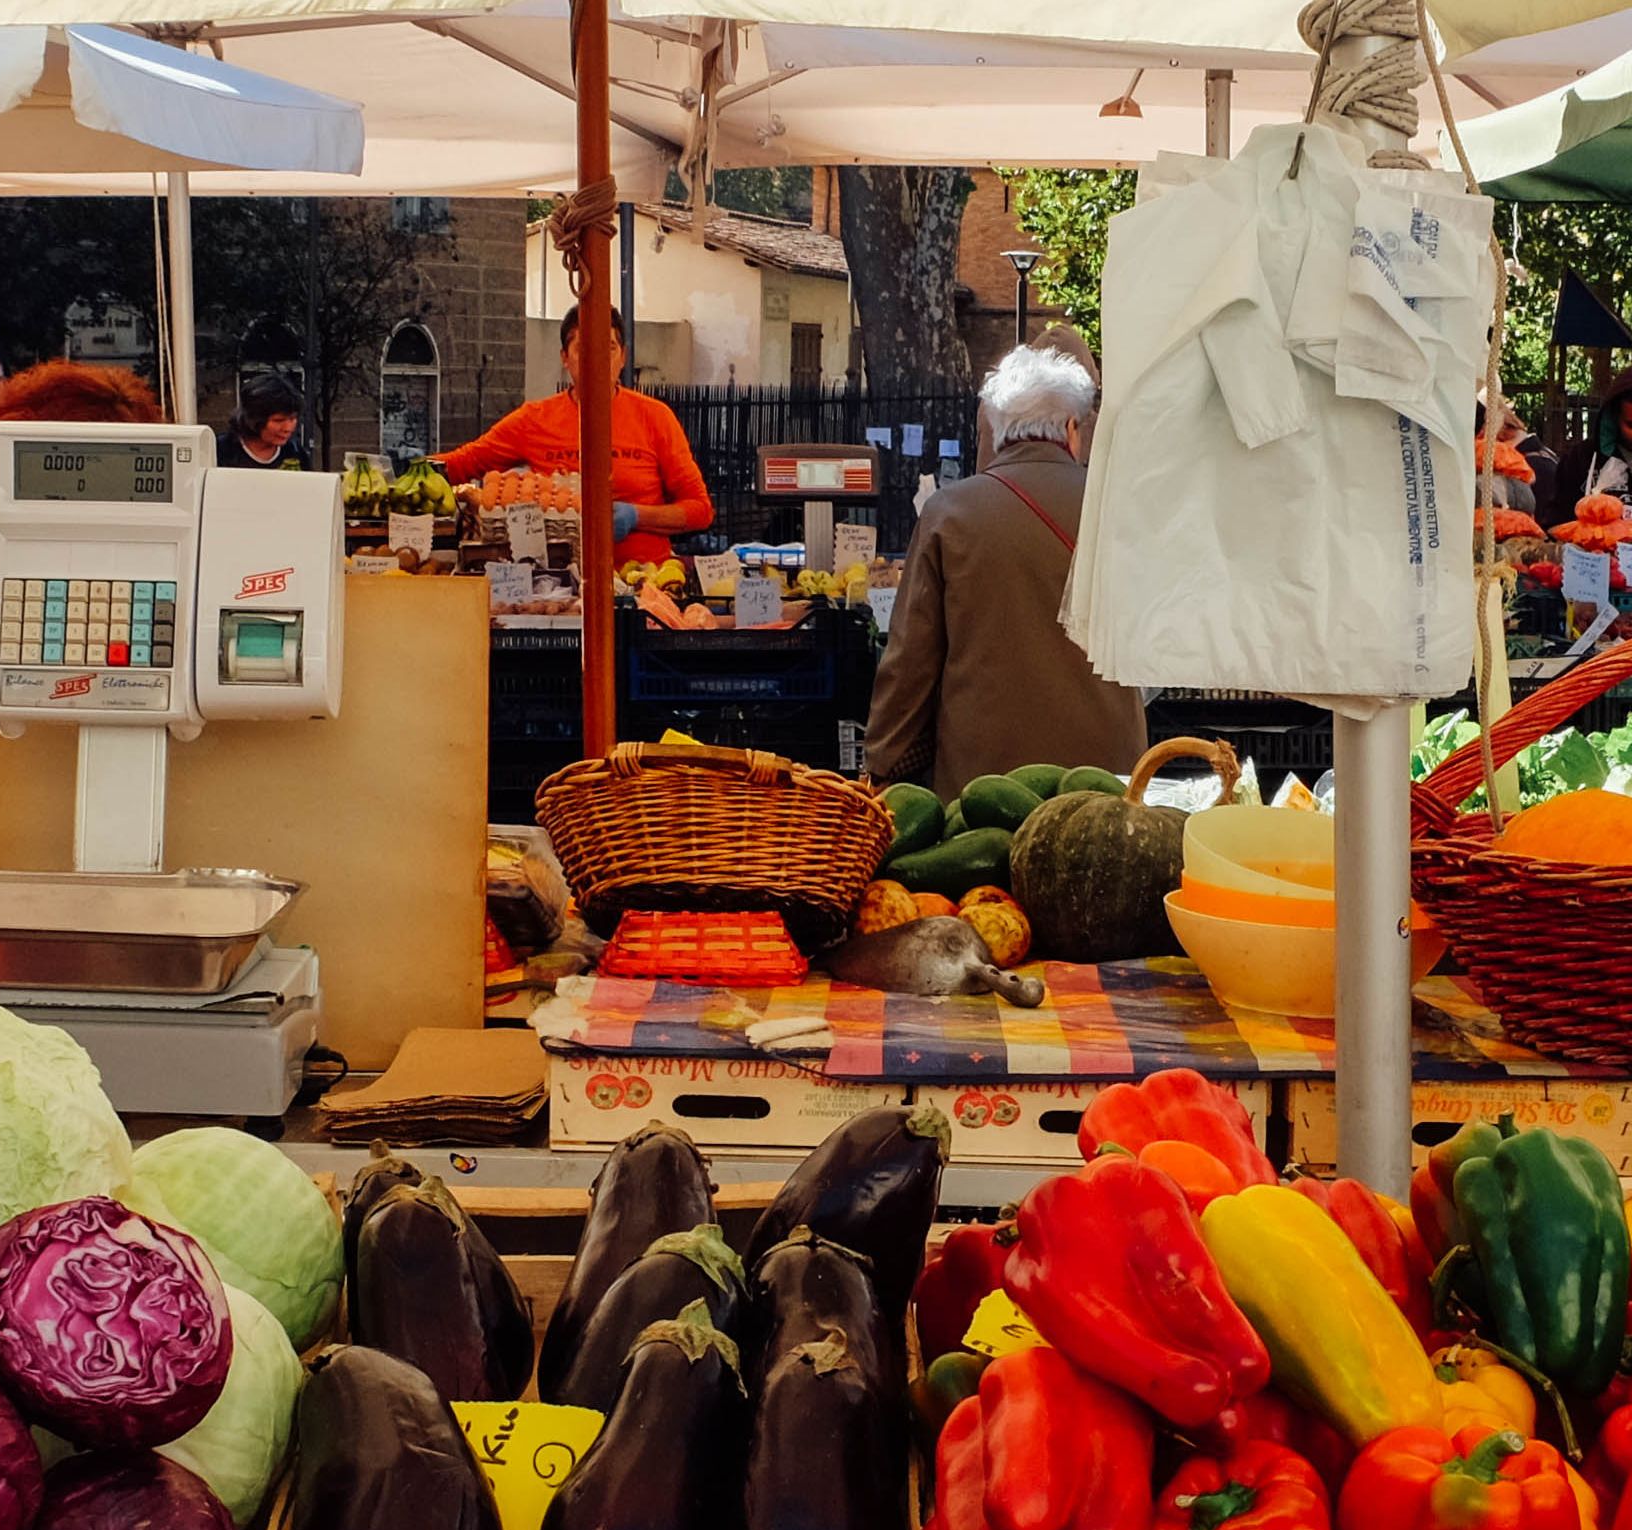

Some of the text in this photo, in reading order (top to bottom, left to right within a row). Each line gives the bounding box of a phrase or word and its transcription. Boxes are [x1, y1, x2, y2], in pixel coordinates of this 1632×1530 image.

[1401, 447, 1418, 501] CONTATTO
[1420, 425, 1440, 550] INVOLGENTE PROTETTIVO
[242, 576, 286, 592] SPES
[55, 677, 89, 694] SPES
[1547, 1100, 1577, 1126] Di
